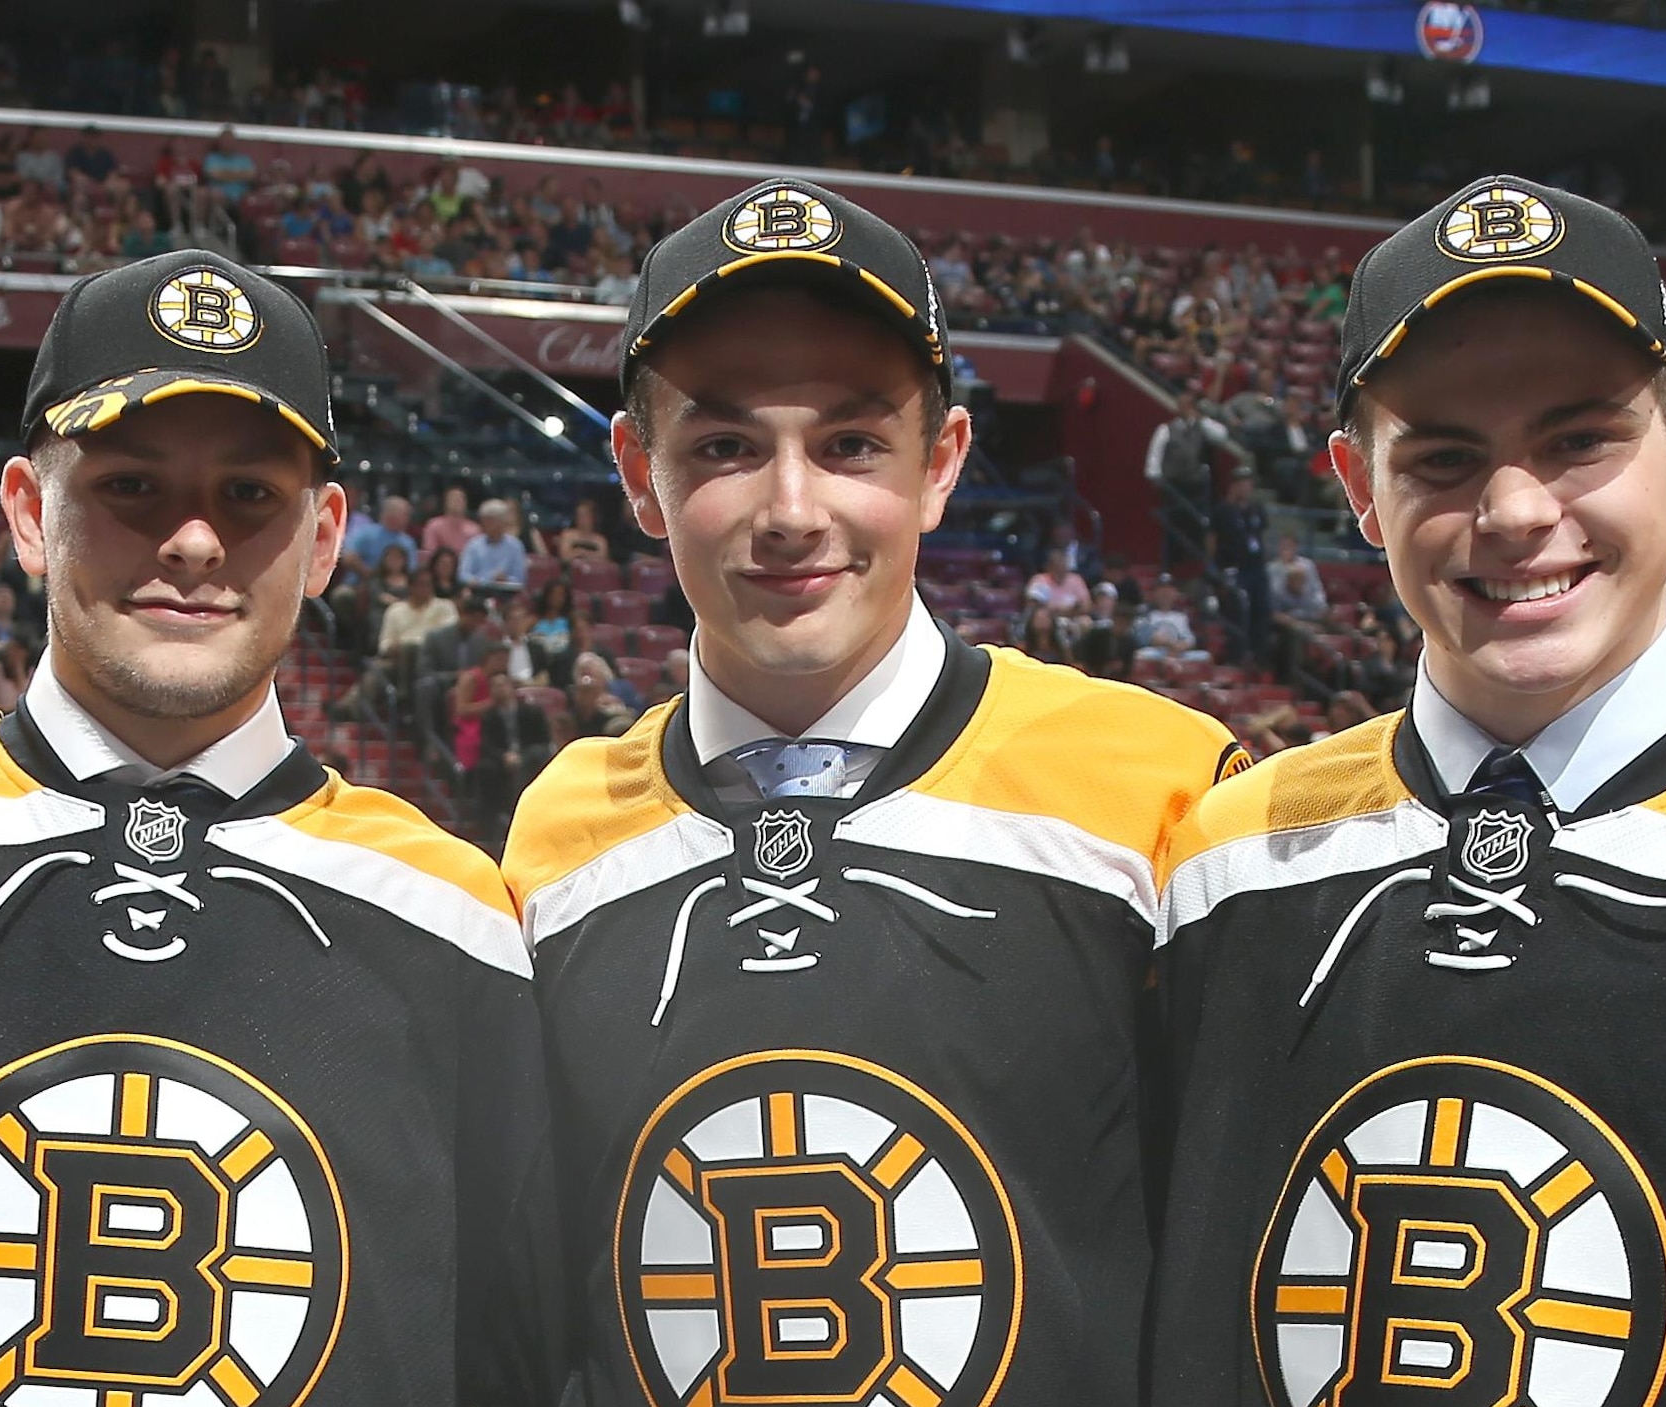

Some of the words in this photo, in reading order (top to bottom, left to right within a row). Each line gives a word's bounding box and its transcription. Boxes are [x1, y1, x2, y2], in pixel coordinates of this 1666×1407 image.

[754, 199, 812, 241] B
[1471, 199, 1530, 243] B
[183, 284, 235, 333] B
[138, 822, 176, 845] NHL
[766, 828, 801, 863] NHL
[1476, 829, 1518, 863] NHL
[24, 1140, 230, 1387] B
[701, 1162, 894, 1403] B
